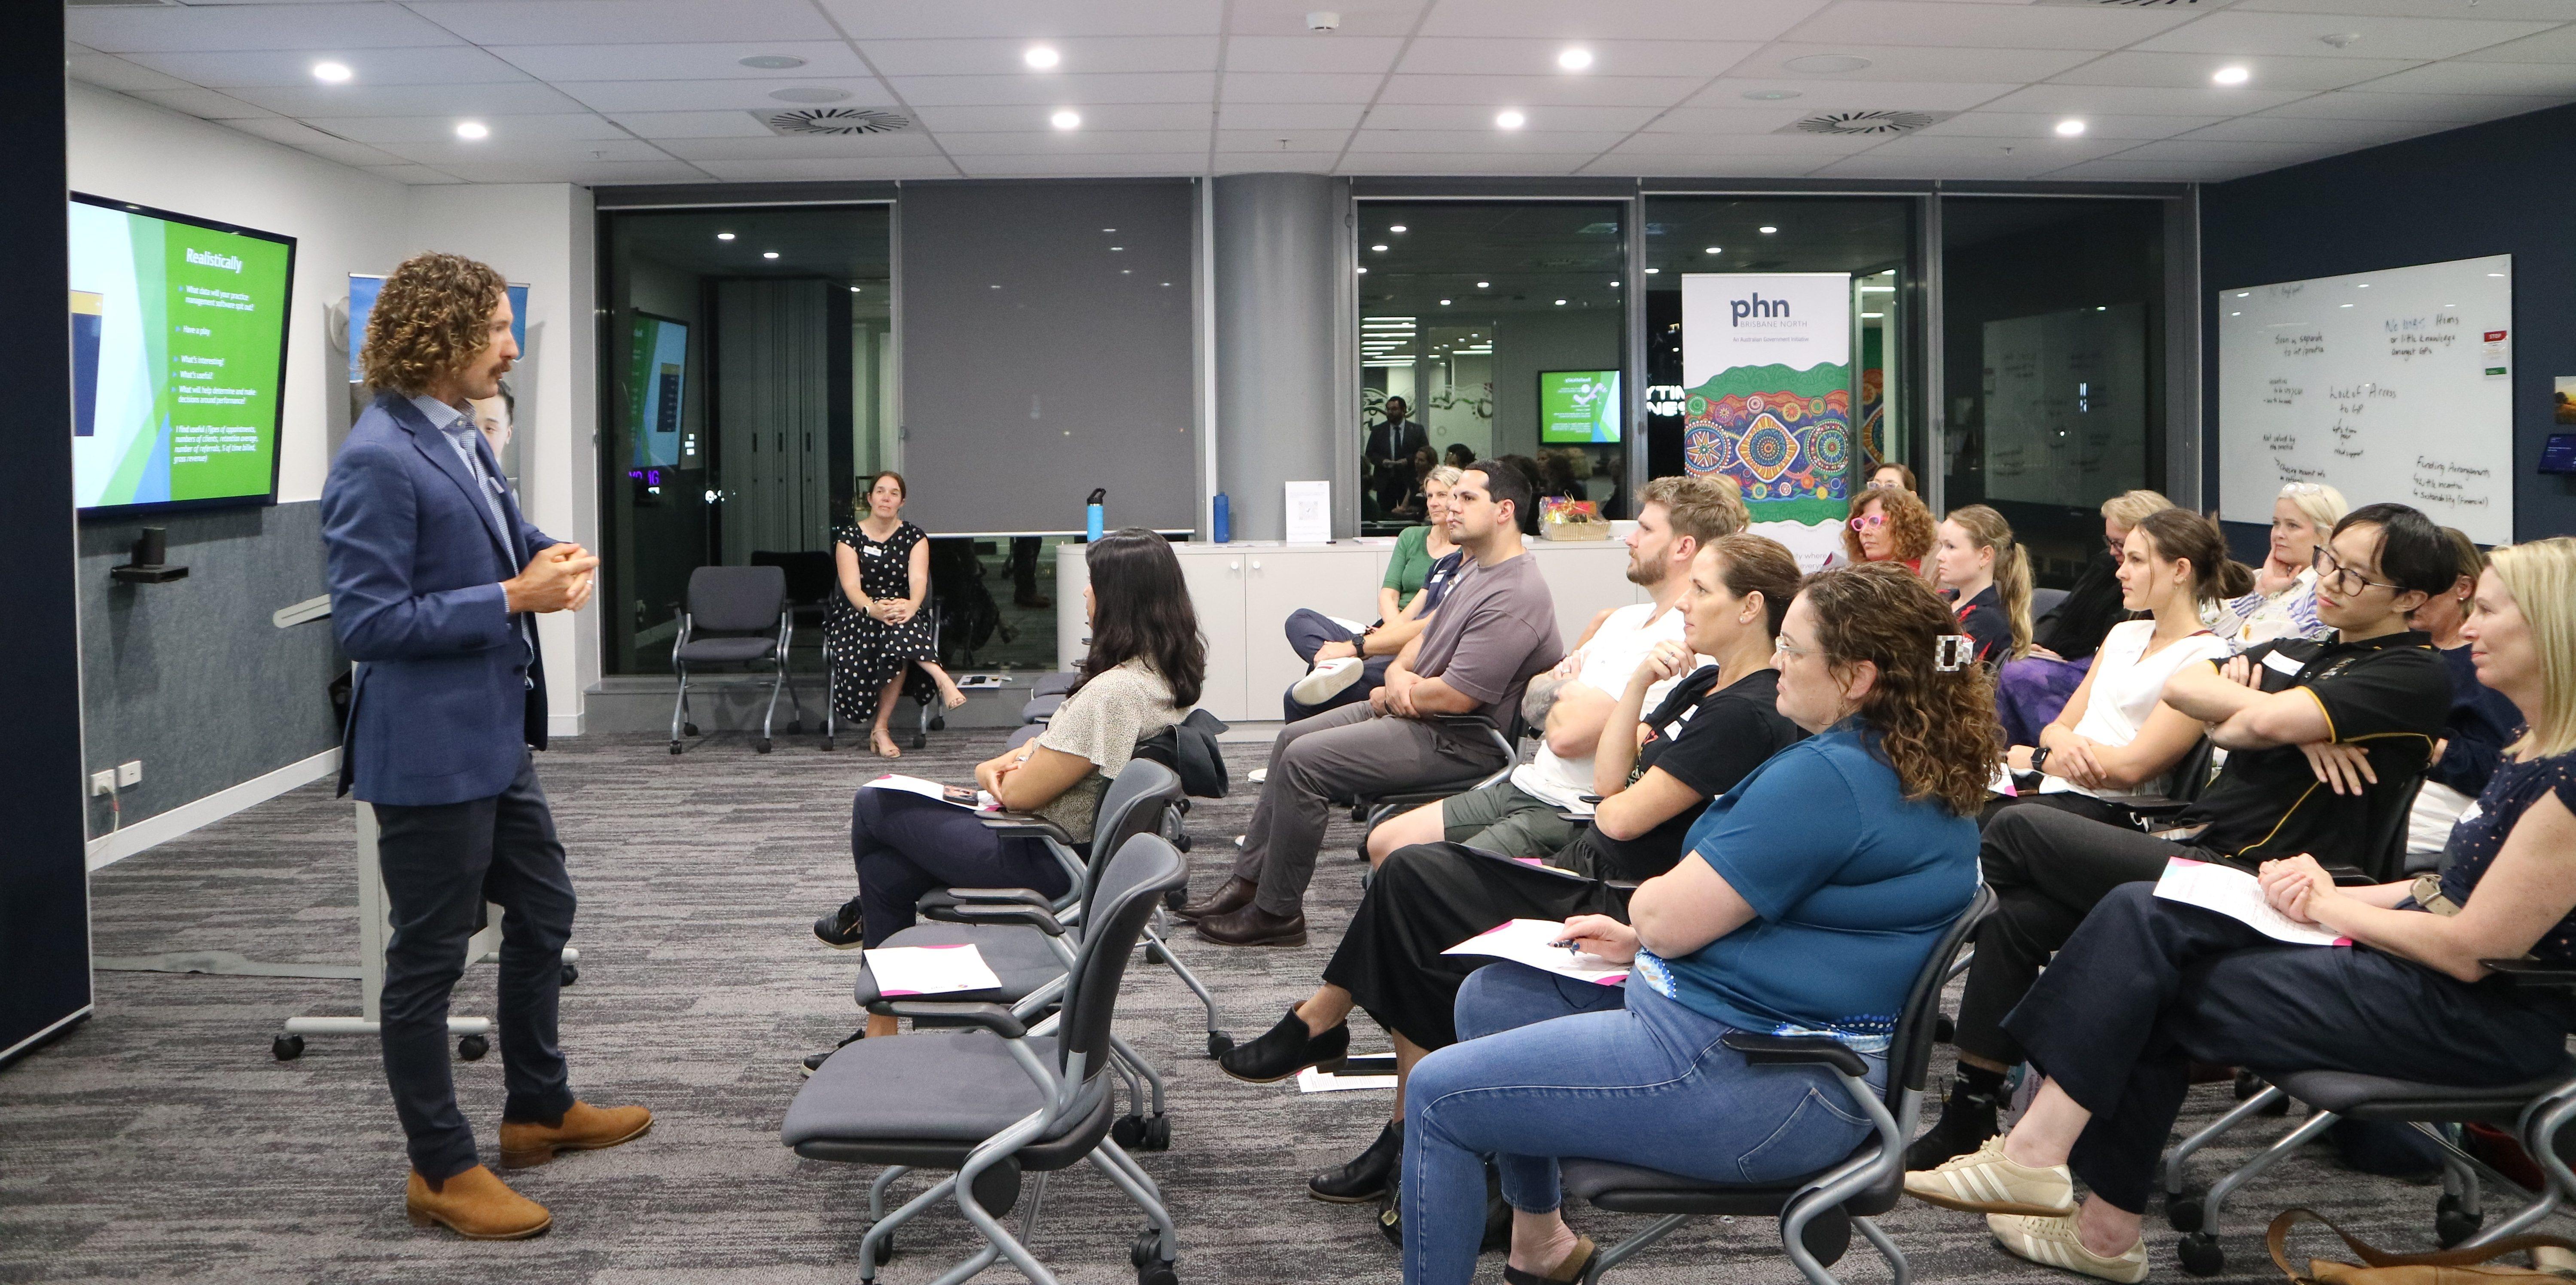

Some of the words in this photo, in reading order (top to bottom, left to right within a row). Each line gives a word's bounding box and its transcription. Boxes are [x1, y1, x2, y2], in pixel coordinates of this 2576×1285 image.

[186, 247, 243, 274] Realistically
[186, 285, 199, 294] What
[199, 287, 210, 295] data
[220, 290, 230, 299] your
[185, 297, 216, 306] management
[216, 300, 235, 308] software
[1730, 292, 1790, 327] phn
[183, 325, 196, 333] Have
[200, 327, 211, 337] play
[181, 355, 198, 363] What's
[198, 356, 225, 367] interesting?
[180, 370, 196, 378] What's
[197, 371, 213, 379] useful?
[179, 385, 191, 393] What
[202, 386, 212, 395] help
[216, 397, 246, 405] performance?
[178, 425, 189, 433] find
[190, 425, 205, 433] useful
[196, 435, 203, 443] of
[193, 445, 200, 453] of
[173, 456, 187, 464] gross
[2417, 455, 2445, 476] Funding
